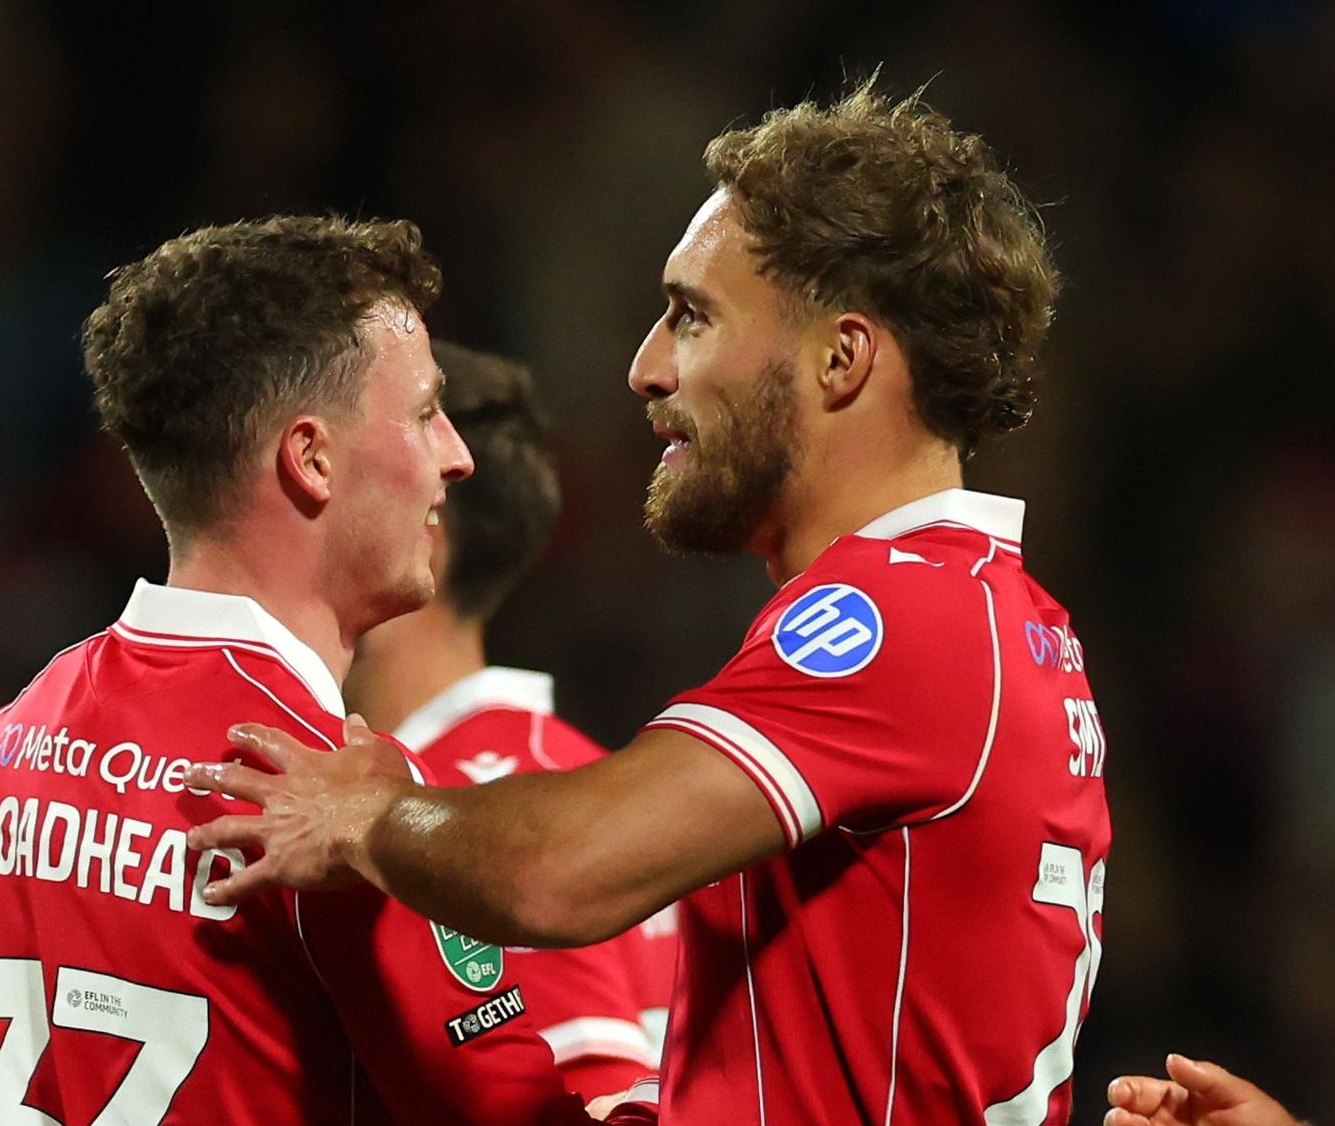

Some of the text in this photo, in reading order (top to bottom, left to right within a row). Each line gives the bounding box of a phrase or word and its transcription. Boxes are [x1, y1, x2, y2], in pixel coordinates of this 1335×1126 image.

[782, 587, 873, 666] hp
[14, 724, 96, 777] Meta
[481, 962, 496, 976] EFL
[84, 990, 122, 1007] EFL IN THE
[84, 1000, 128, 1018] COMMUNITY
